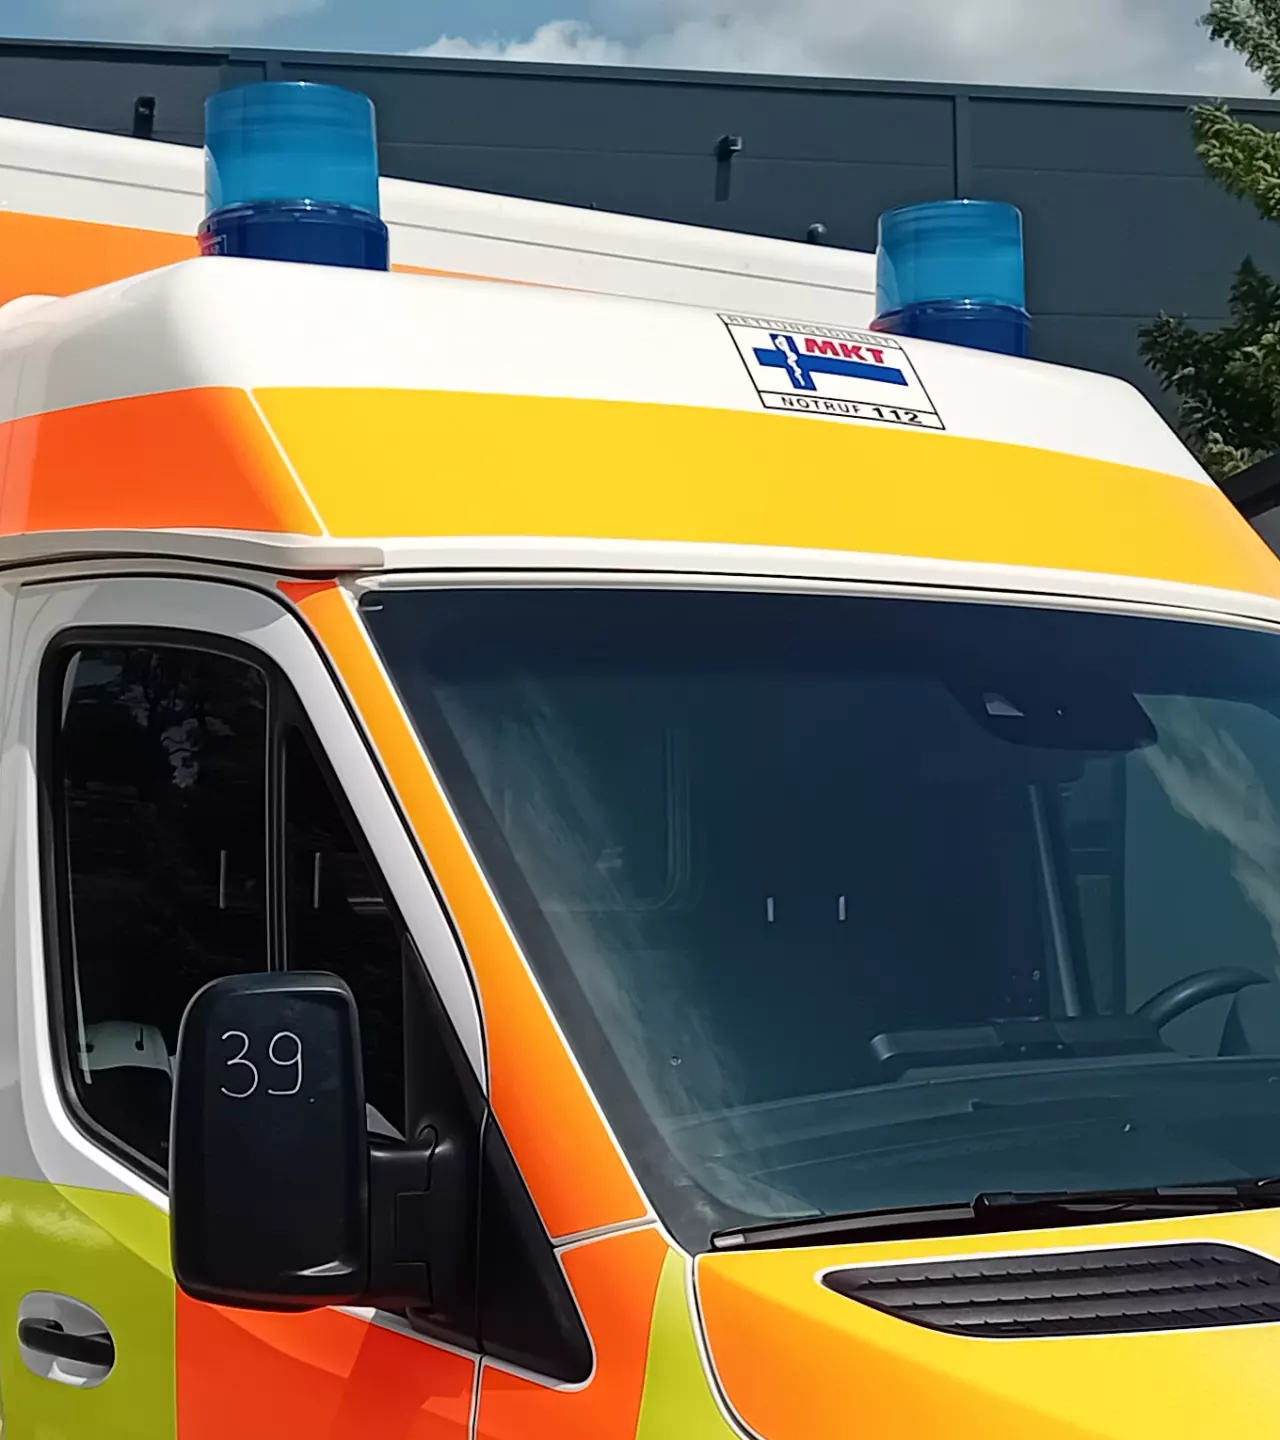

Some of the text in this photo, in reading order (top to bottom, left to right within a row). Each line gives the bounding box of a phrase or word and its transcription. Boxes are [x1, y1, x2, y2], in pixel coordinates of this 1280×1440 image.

[804, 337, 885, 364] MKT
[781, 396, 923, 424] NOTRUF 112
[221, 1030, 302, 1098] 39
